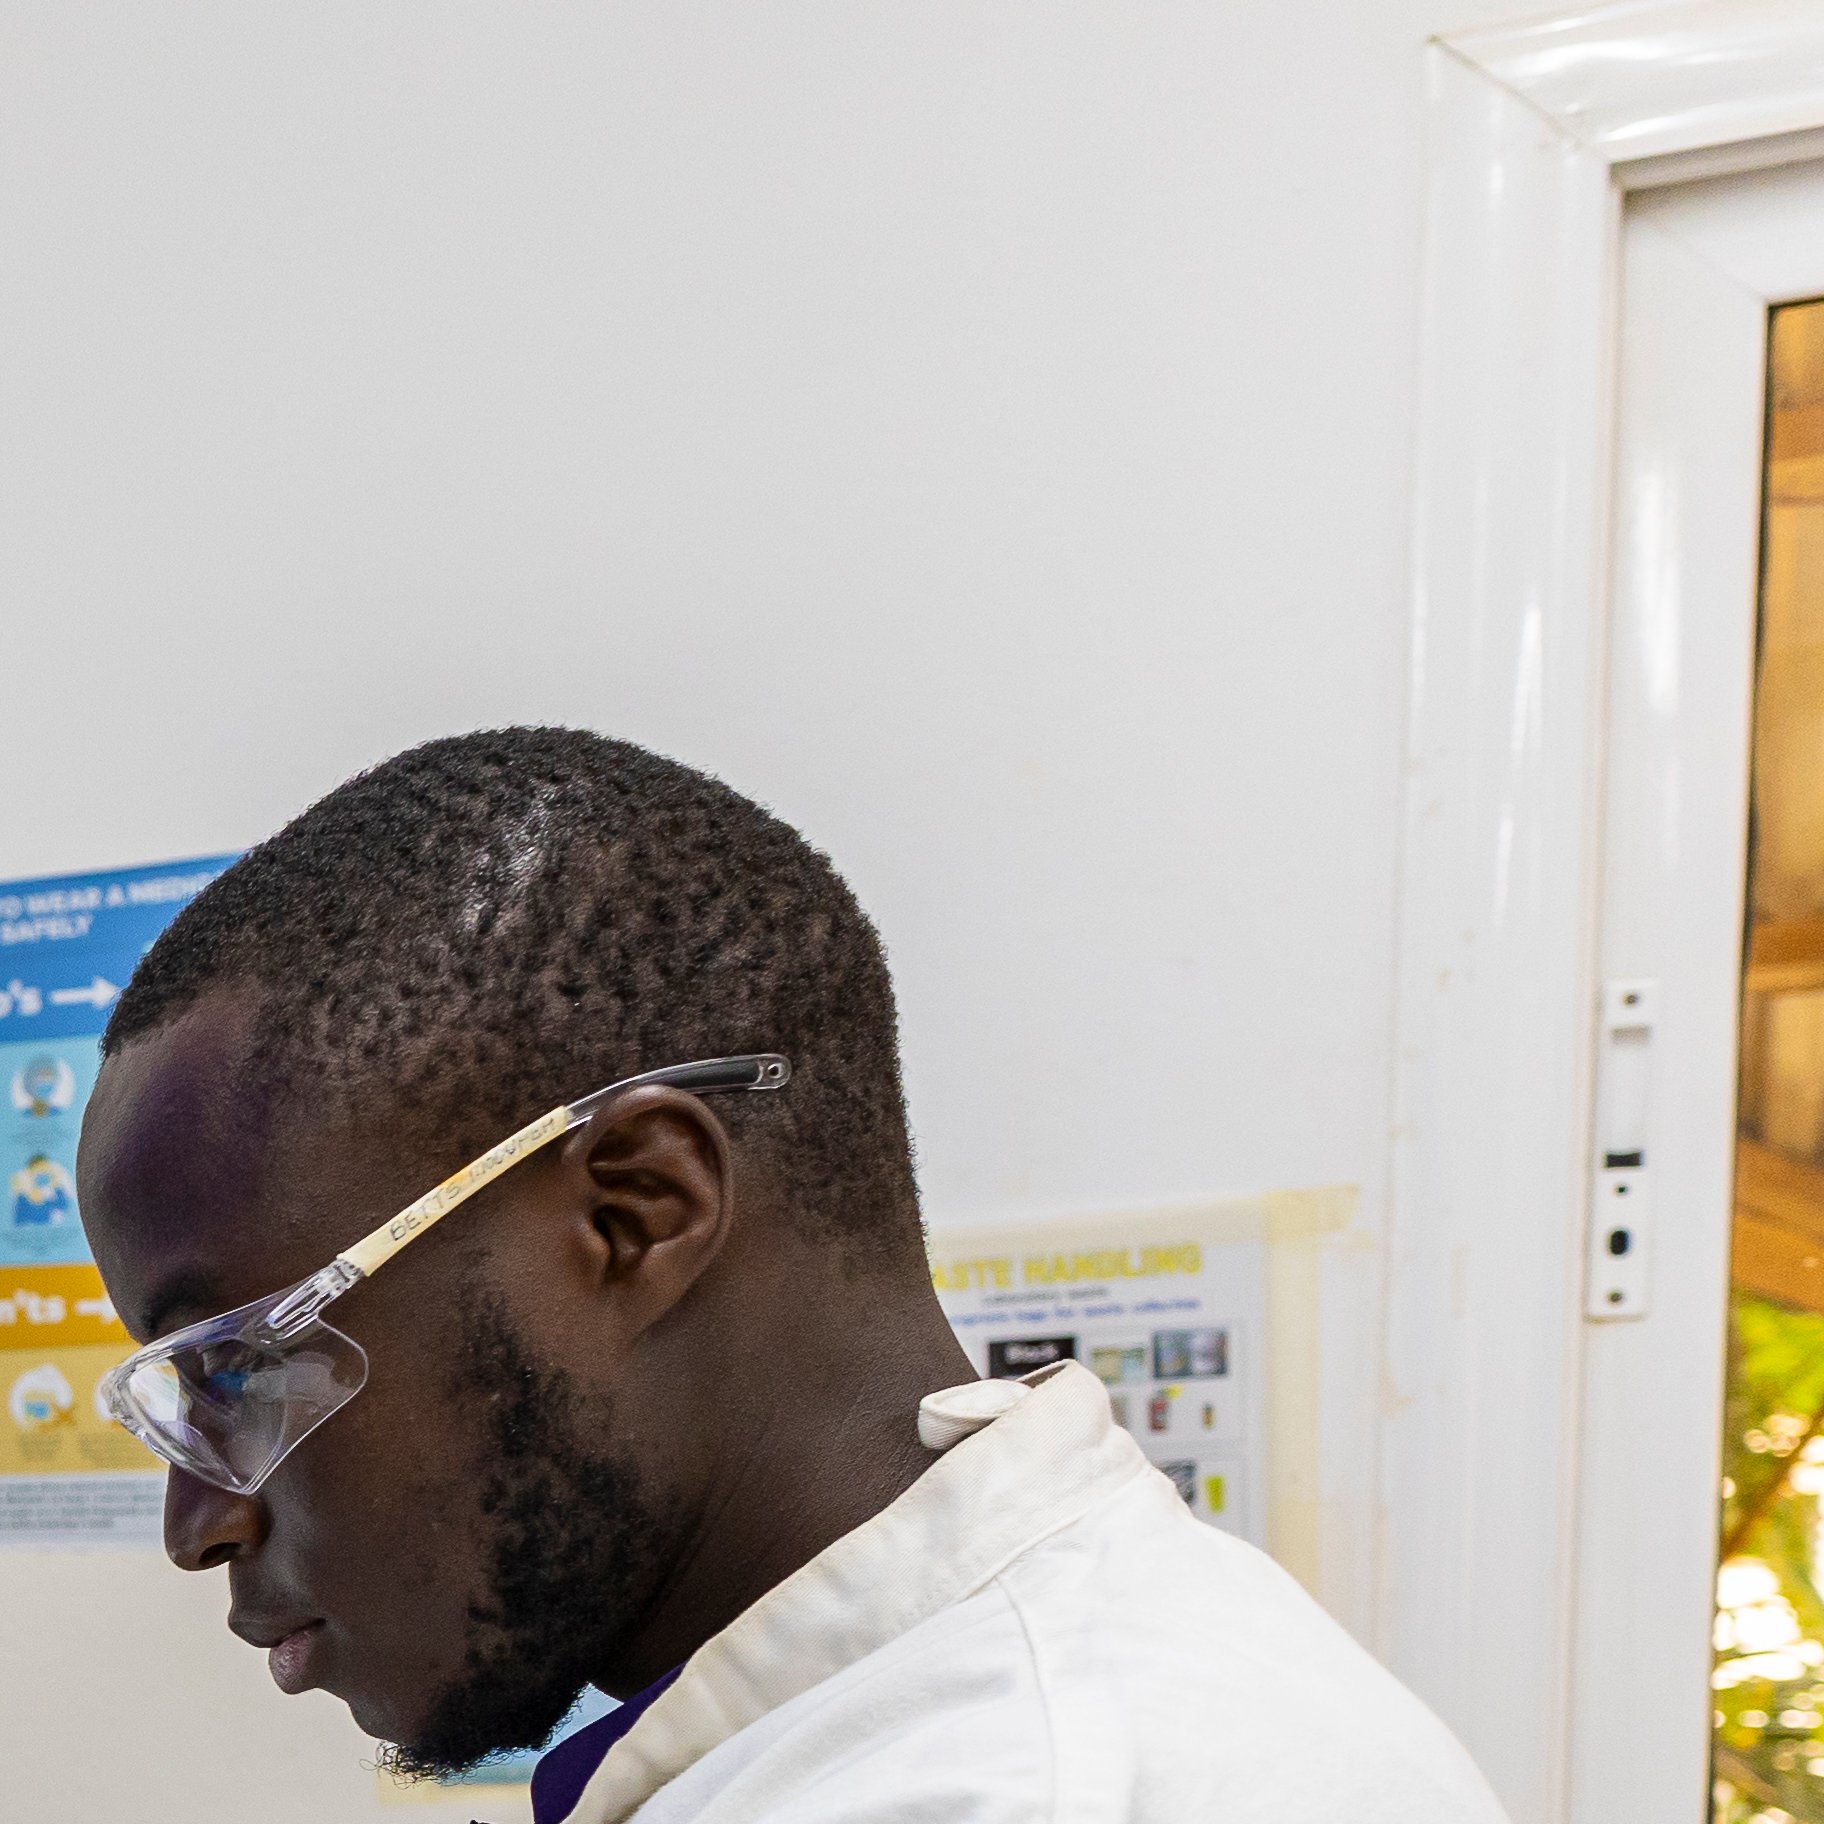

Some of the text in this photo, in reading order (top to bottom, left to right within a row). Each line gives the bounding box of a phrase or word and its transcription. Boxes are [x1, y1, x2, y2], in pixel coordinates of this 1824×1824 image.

[26, 887, 102, 916] WEAR
[106, 883, 124, 906] A
[0, 914, 92, 943] SAFELY
[932, 1243, 1202, 1291] ASTE HANDLING
